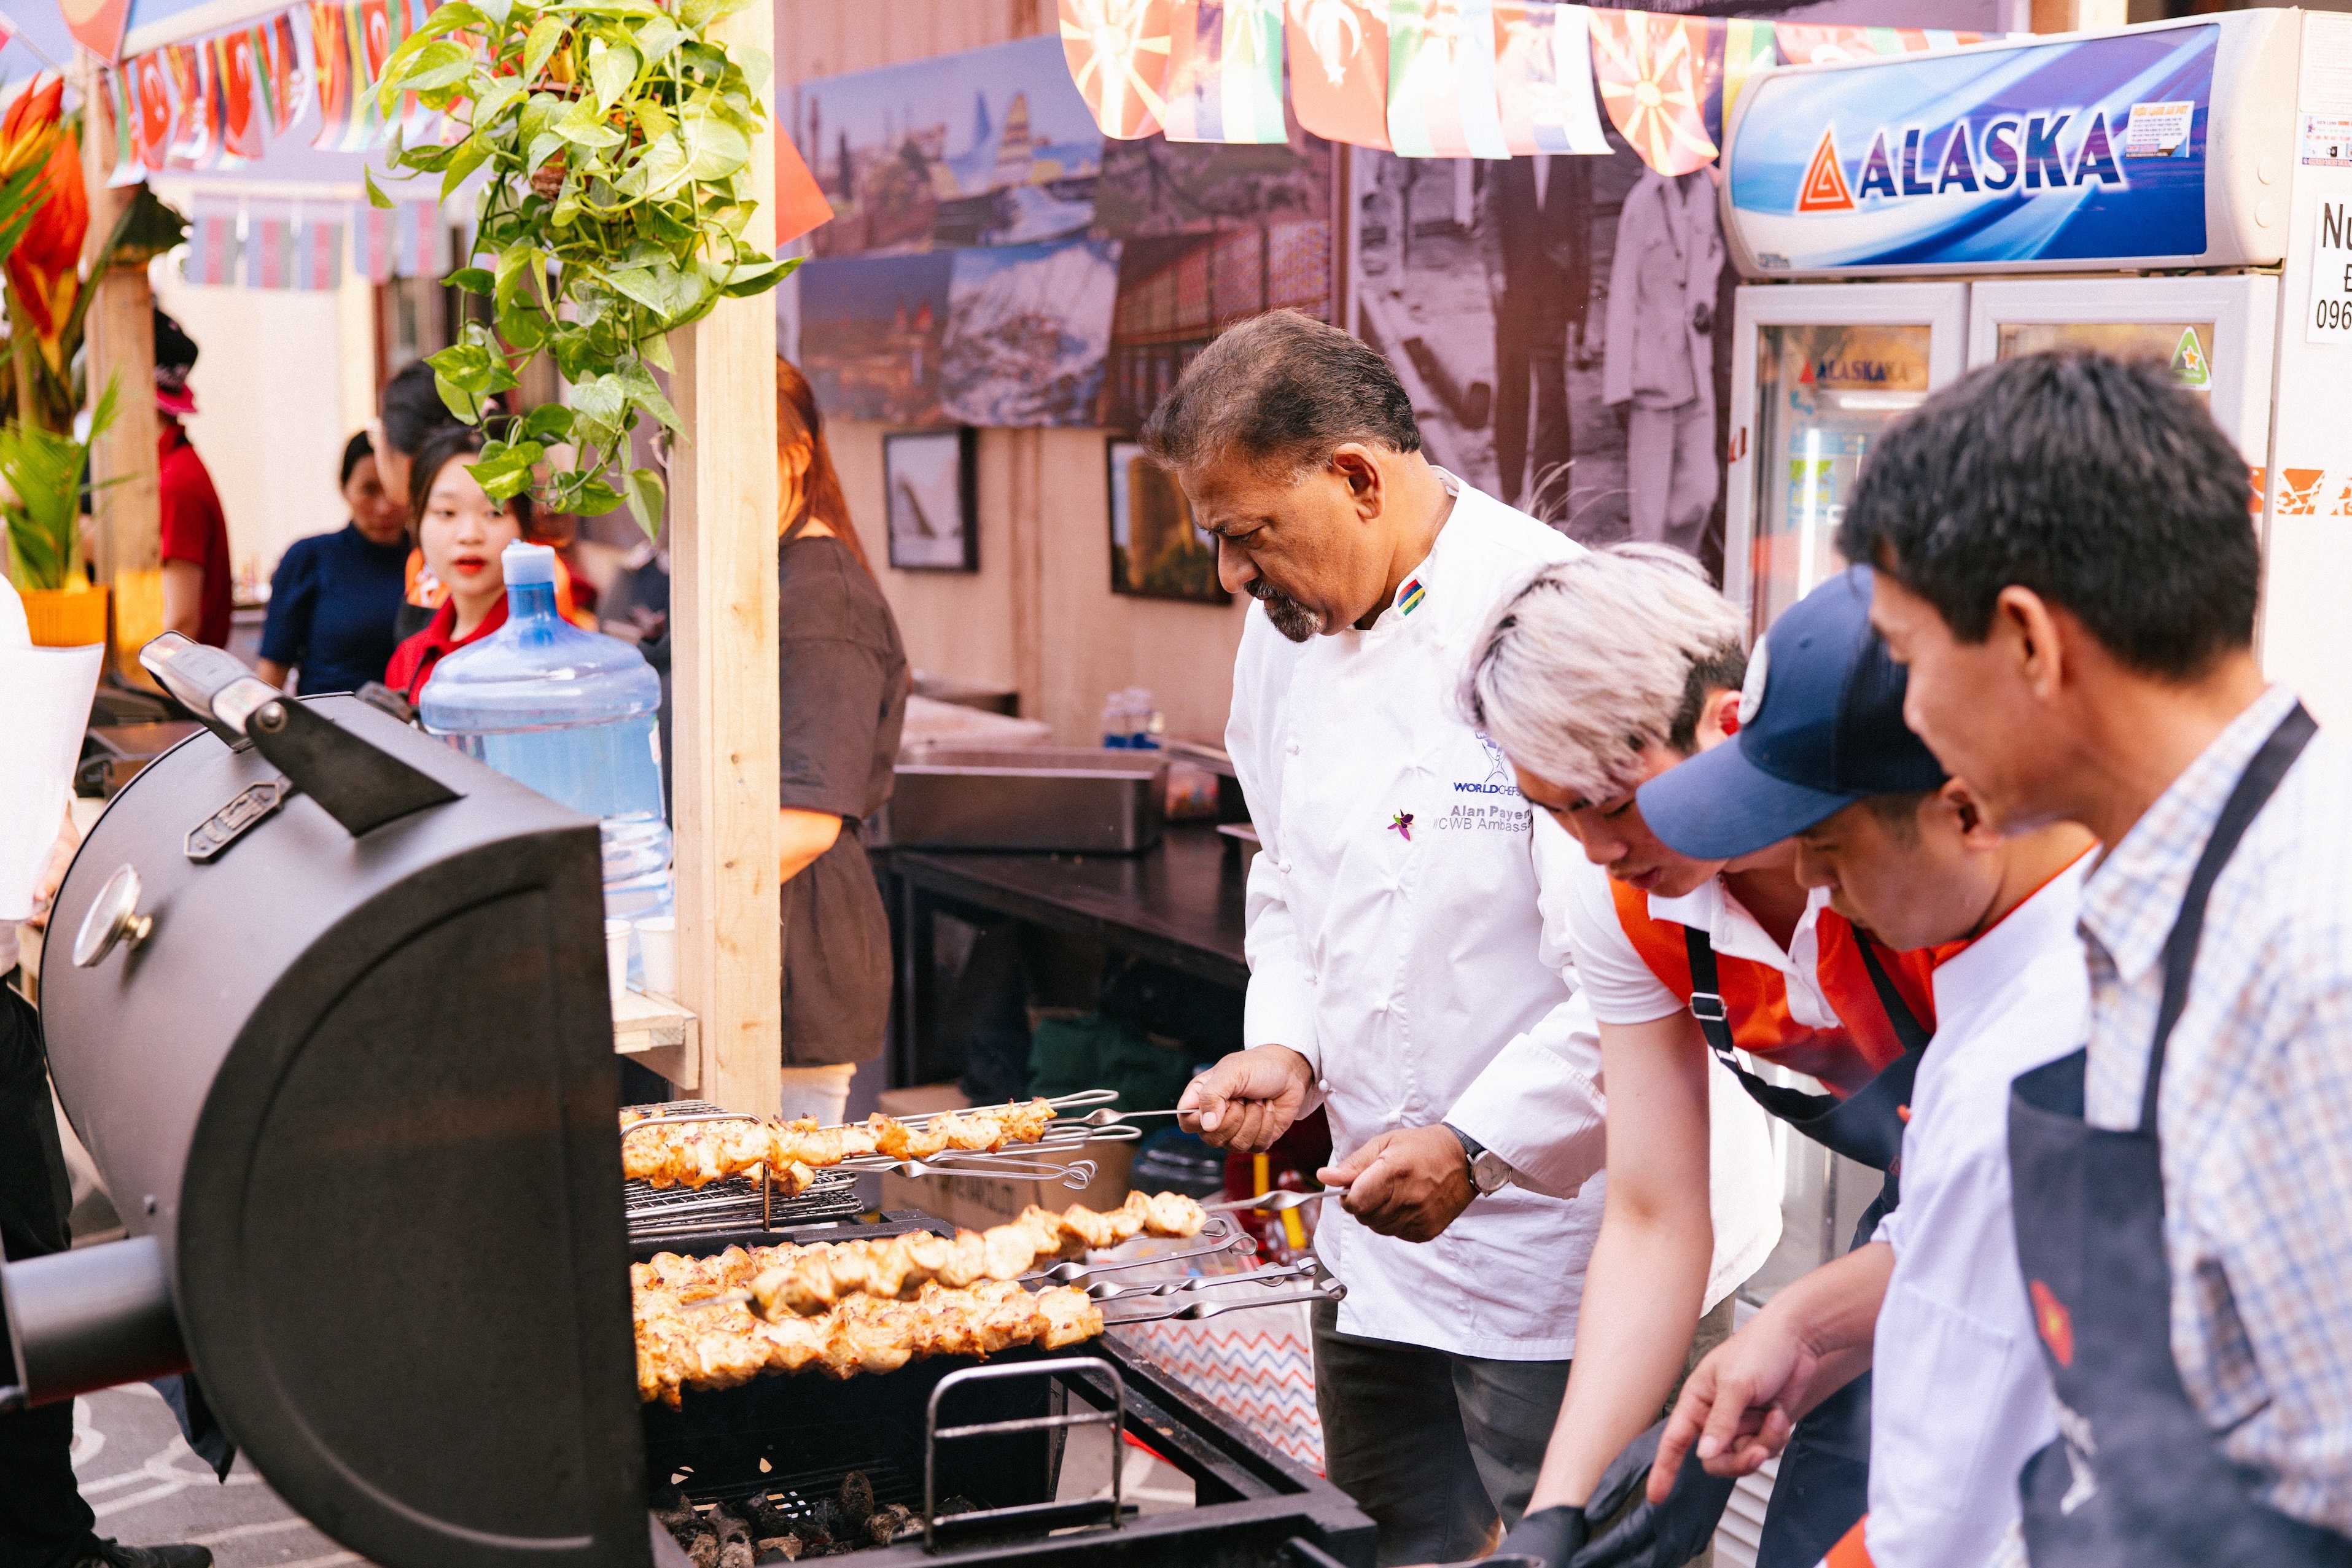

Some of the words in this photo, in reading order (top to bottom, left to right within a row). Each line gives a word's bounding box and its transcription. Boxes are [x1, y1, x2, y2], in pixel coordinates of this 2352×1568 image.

[1859, 111, 2122, 199] ALASKA
[1816, 359, 1886, 382] ALASKA
[1450, 805, 1486, 817] Alan
